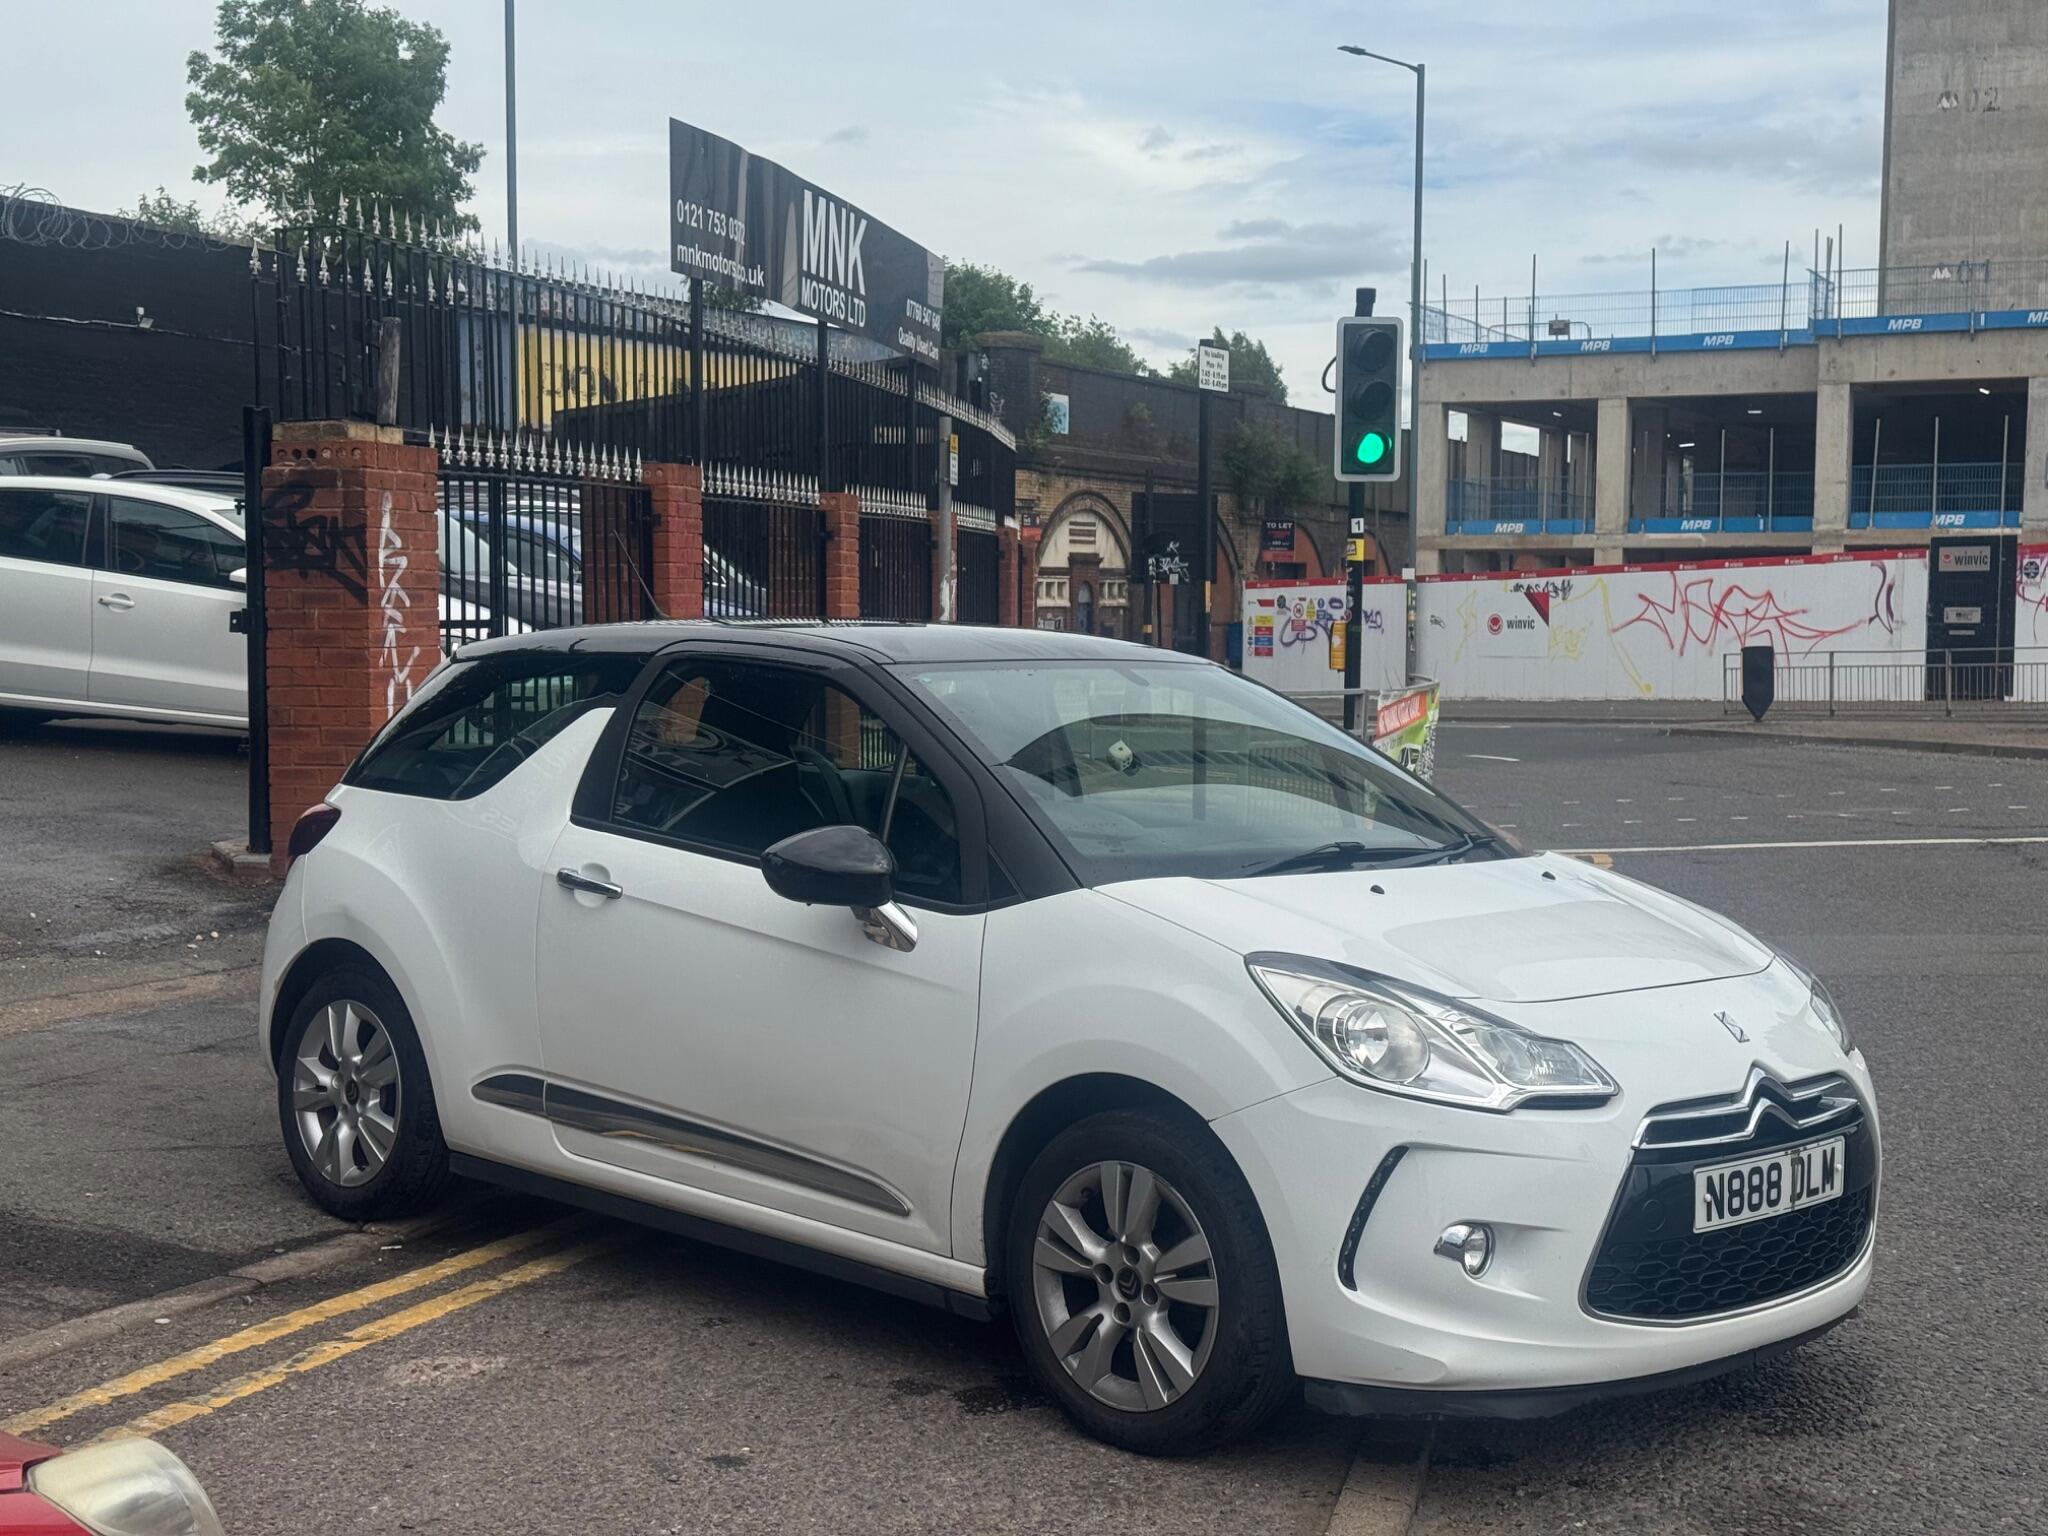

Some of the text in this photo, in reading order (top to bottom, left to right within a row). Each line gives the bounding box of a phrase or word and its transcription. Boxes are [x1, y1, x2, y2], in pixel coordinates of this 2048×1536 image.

[677, 199, 703, 230] 0121
[707, 208, 727, 238] 753
[803, 189, 868, 296] MNK
[801, 276, 867, 328] MOTORS LTD
[1887, 318, 1923, 330] MPB
[2027, 311, 2048, 324] MP
[898, 326, 916, 354] Quality
[1580, 340, 1611, 352] MPB
[1703, 334, 1736, 347] MPB
[1459, 343, 1489, 355] MPB
[1354, 520, 1361, 531] 1
[1680, 519, 1712, 530] MPB
[1929, 514, 1966, 526] MPB
[1494, 523, 1525, 534] MPB
[1954, 551, 1989, 566] winvic
[1506, 616, 1536, 630] winvic
[1706, 1147, 1836, 1222] N888 DLM
